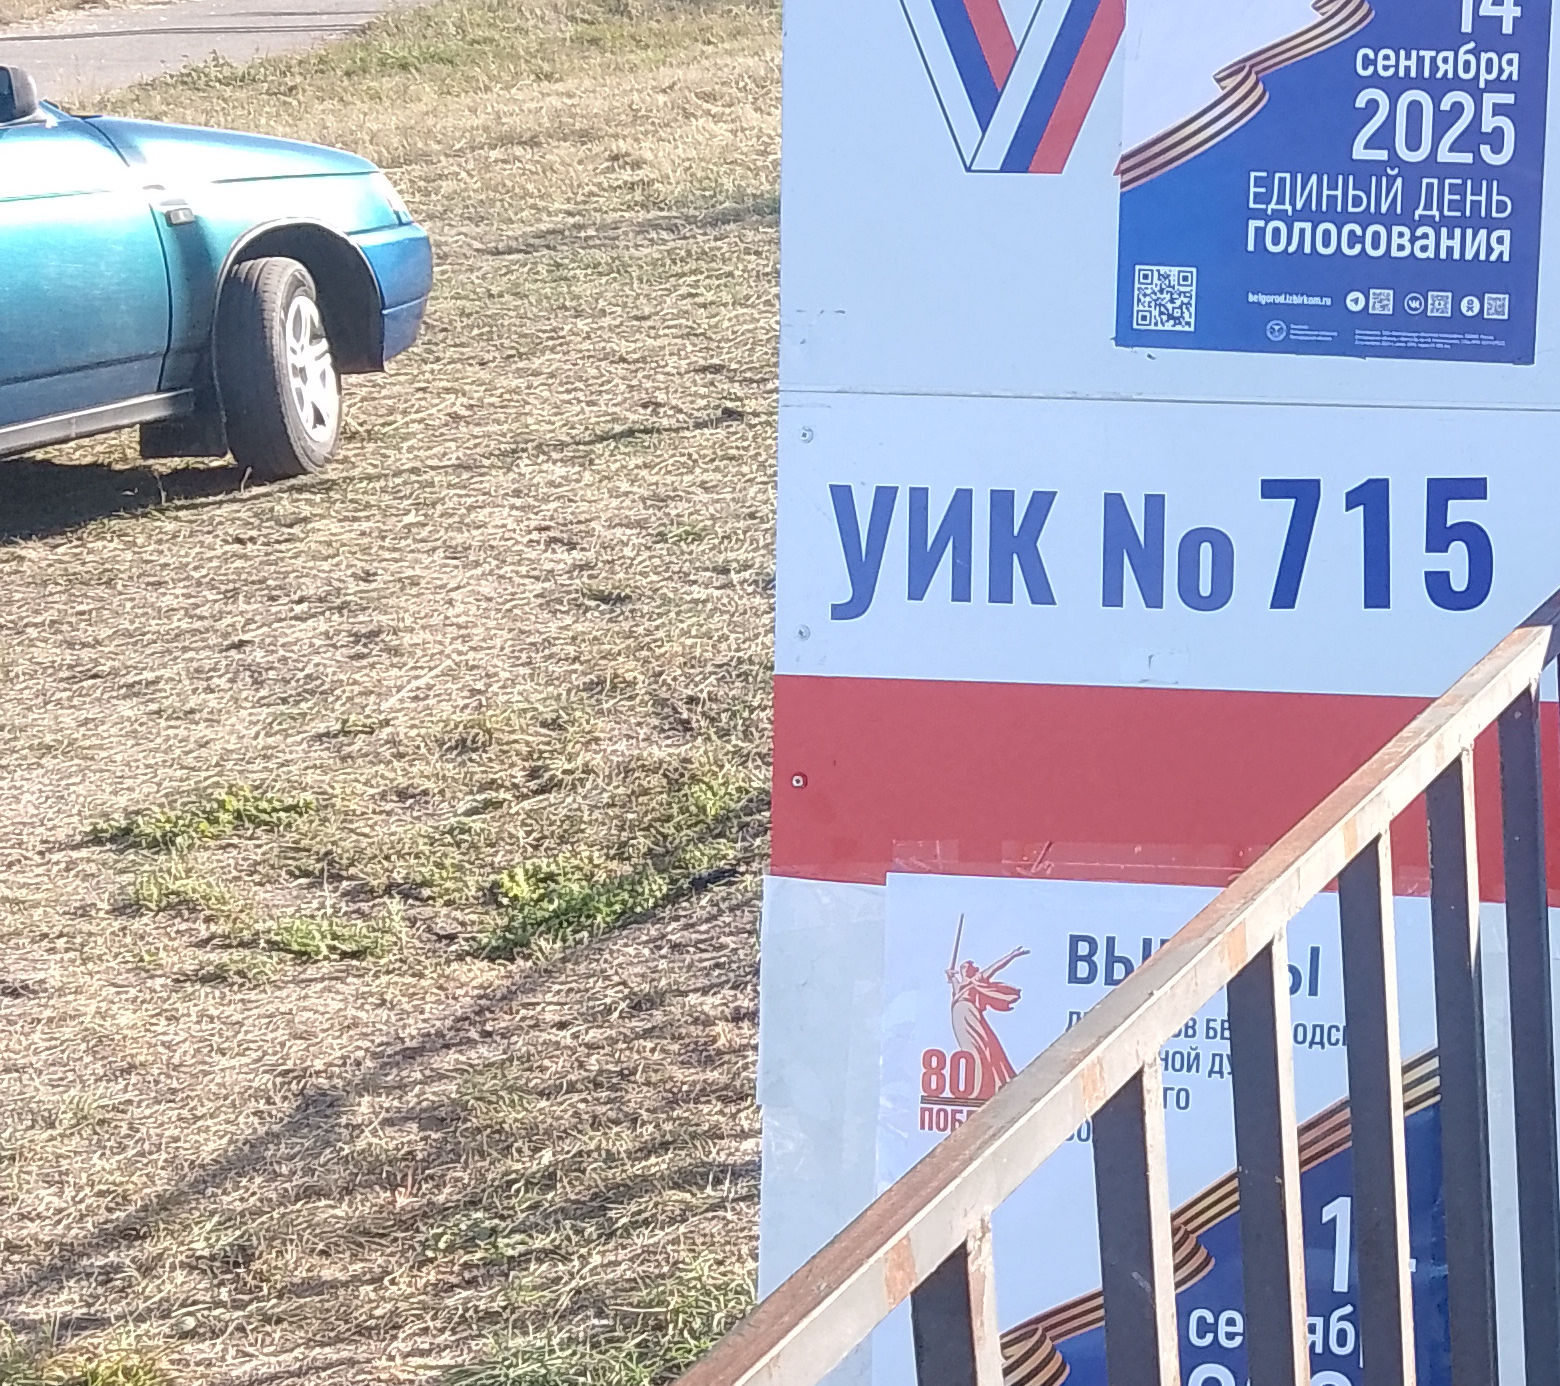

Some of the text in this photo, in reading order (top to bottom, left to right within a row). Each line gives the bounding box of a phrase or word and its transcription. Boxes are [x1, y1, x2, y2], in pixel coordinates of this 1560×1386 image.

[1355, 40, 1520, 89] сентября
[1351, 88, 1516, 166] 2025
[1248, 166, 1513, 223] ЕДИНЫЙ ДЕНЬ
[1246, 219, 1512, 263] голосования
[828, 483, 1059, 621] УИК
[921, 1048, 976, 1099] 80
